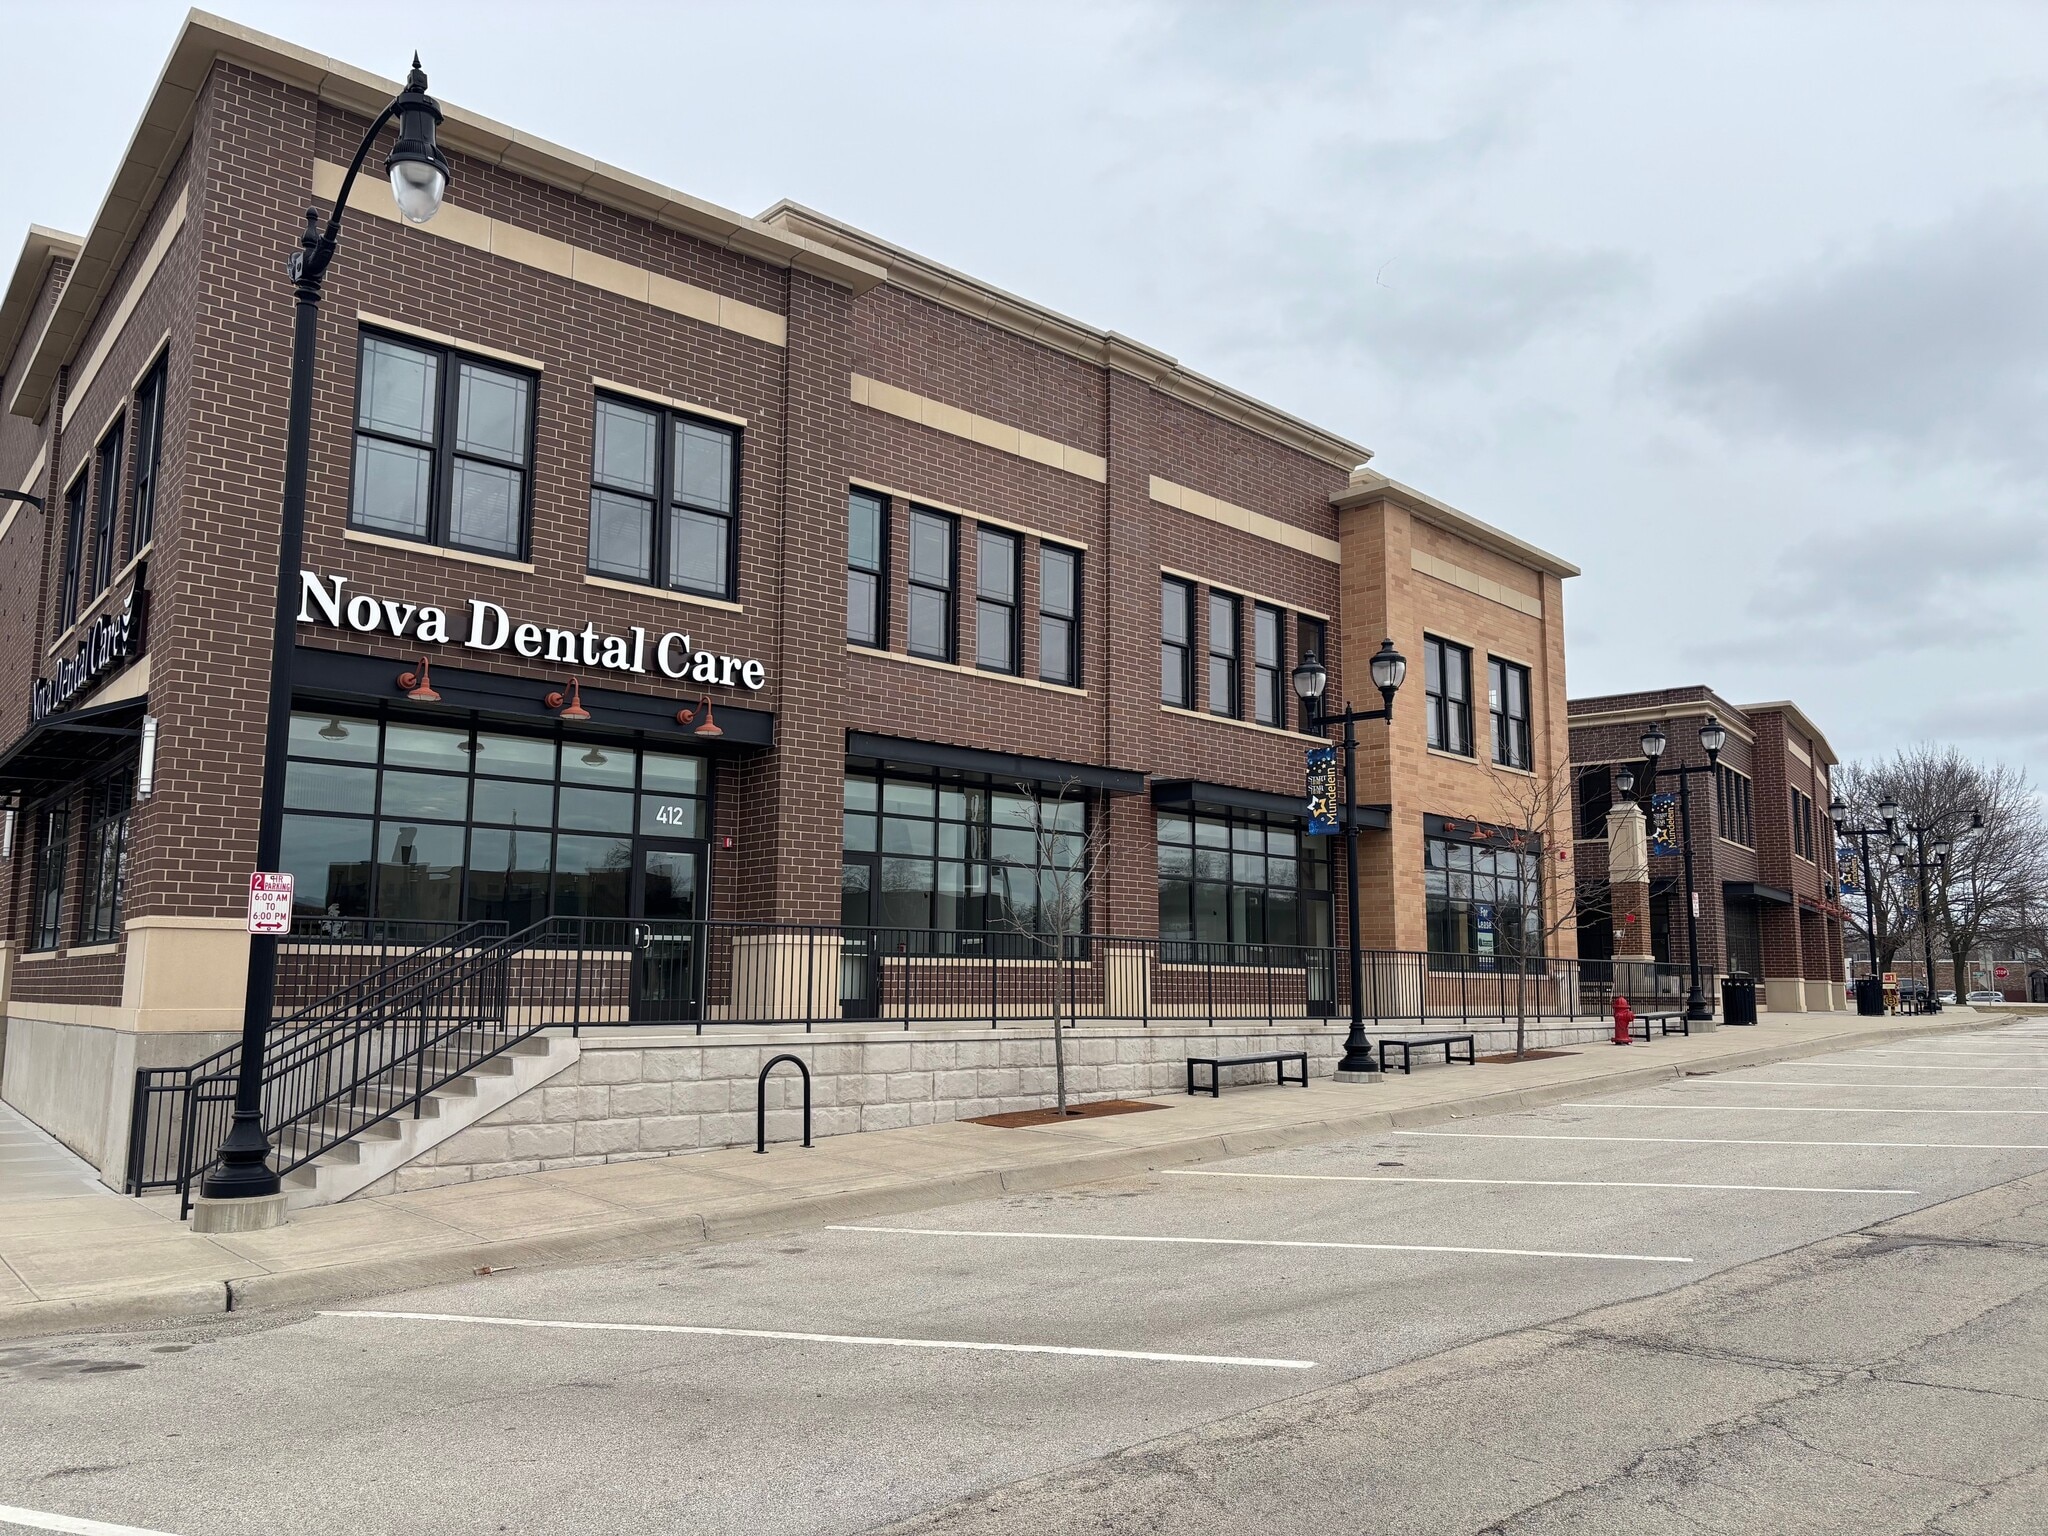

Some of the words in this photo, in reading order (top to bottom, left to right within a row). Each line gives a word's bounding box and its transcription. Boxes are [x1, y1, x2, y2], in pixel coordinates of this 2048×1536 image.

[297, 570, 450, 644] Nova
[465, 598, 646, 674] Dental
[657, 632, 766, 690] Care
[53, 627, 93, 709] Dental
[91, 616, 120, 675] Care
[1325, 767, 1338, 825] Mundelein
[656, 805, 683, 825] 412
[254, 874, 263, 890] 2
[264, 882, 291, 891] PARKING
[254, 893, 274, 901] 6:00
[275, 893, 288, 902] AM
[265, 902, 276, 911] TO
[252, 912, 272, 920] 6:00
[274, 912, 287, 921] PM
[1477, 918, 1492, 929] Lease
